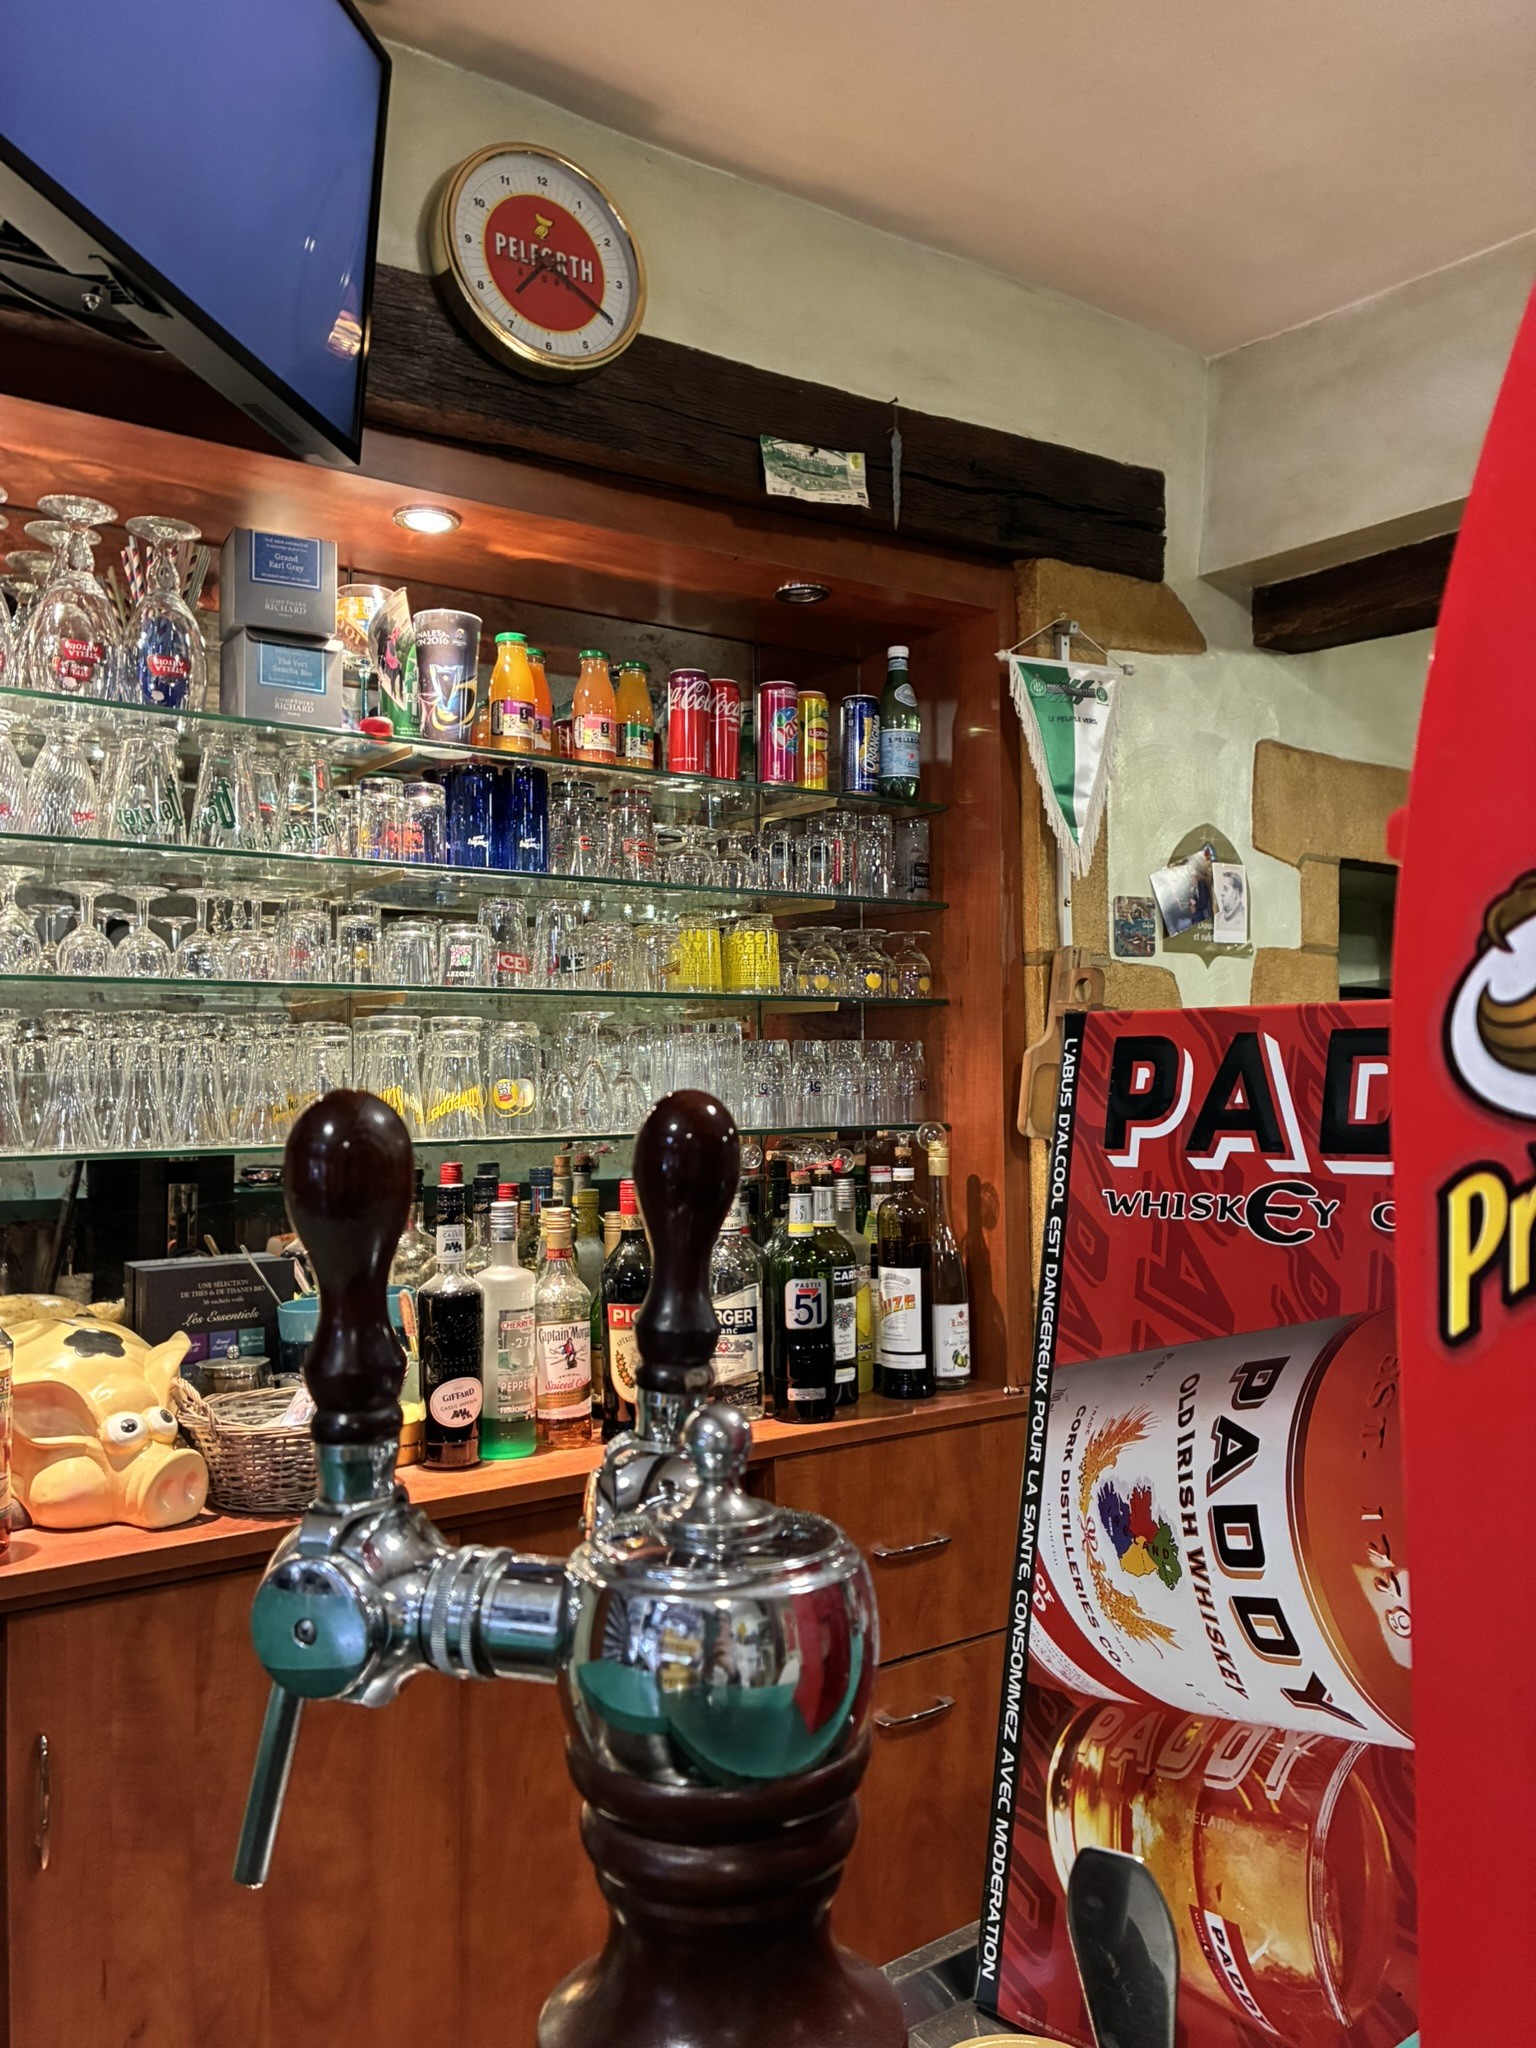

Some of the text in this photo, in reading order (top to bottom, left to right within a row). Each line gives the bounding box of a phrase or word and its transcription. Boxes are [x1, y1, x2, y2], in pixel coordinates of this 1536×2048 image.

[500, 175, 510, 186] 11
[536, 176, 548, 187] 12
[473, 197, 485, 208] 10
[464, 233, 473, 244] 9
[604, 238, 611, 247] 2
[477, 280, 485, 290] 8
[615, 280, 623, 290] 3
[507, 319, 516, 329] 7
[545, 341, 552, 351] 6
[582, 340, 589, 350] 5
[274, 552, 299, 563] Grand
[268, 560, 305, 574] Earl Grey
[264, 602, 307, 615] RICHARD
[155, 665, 184, 674] STELLA
[274, 702, 314, 714] RICHARD
[1060, 1038, 1078, 1107] L'ABUS
[809, 1080, 821, 1092] 51
[1051, 1113, 1071, 1210] D'ALCOOL
[1102, 1180, 1340, 1246] WHISKEY
[1047, 1216, 1062, 1258] EST
[198, 1282, 212, 1290] UNE
[226, 1286, 253, 1294] TISANES
[253, 1284, 266, 1292] BIO
[181, 1307, 260, 1327] Les Essentiels
[794, 1293, 822, 1326] 51
[502, 1321, 528, 1330] CHERRY
[1035, 1263, 1058, 1395] DANGEREUX
[538, 1326, 569, 1345] Captain
[545, 1380, 573, 1391] Spiced
[1085, 1405, 1099, 1435] TRADE
[1029, 1400, 1046, 1463] POUR
[1026, 1470, 1040, 1496] LA
[1060, 1405, 1123, 1668] CORK DISTILLERIES CO.
[1177, 1372, 1250, 1700] OLD IRISH WHISKEY
[1206, 1356, 1368, 1730] PADDY
[1114, 1636, 1136, 1664] MARK
[1004, 1589, 1029, 1744] CONSOMMEZ
[1077, 1706, 1324, 1800] PADDY
[997, 1747, 1015, 1814] AVEC
[981, 1817, 1009, 1981] MODERATION
[1211, 1925, 1274, 2031] PADDY
